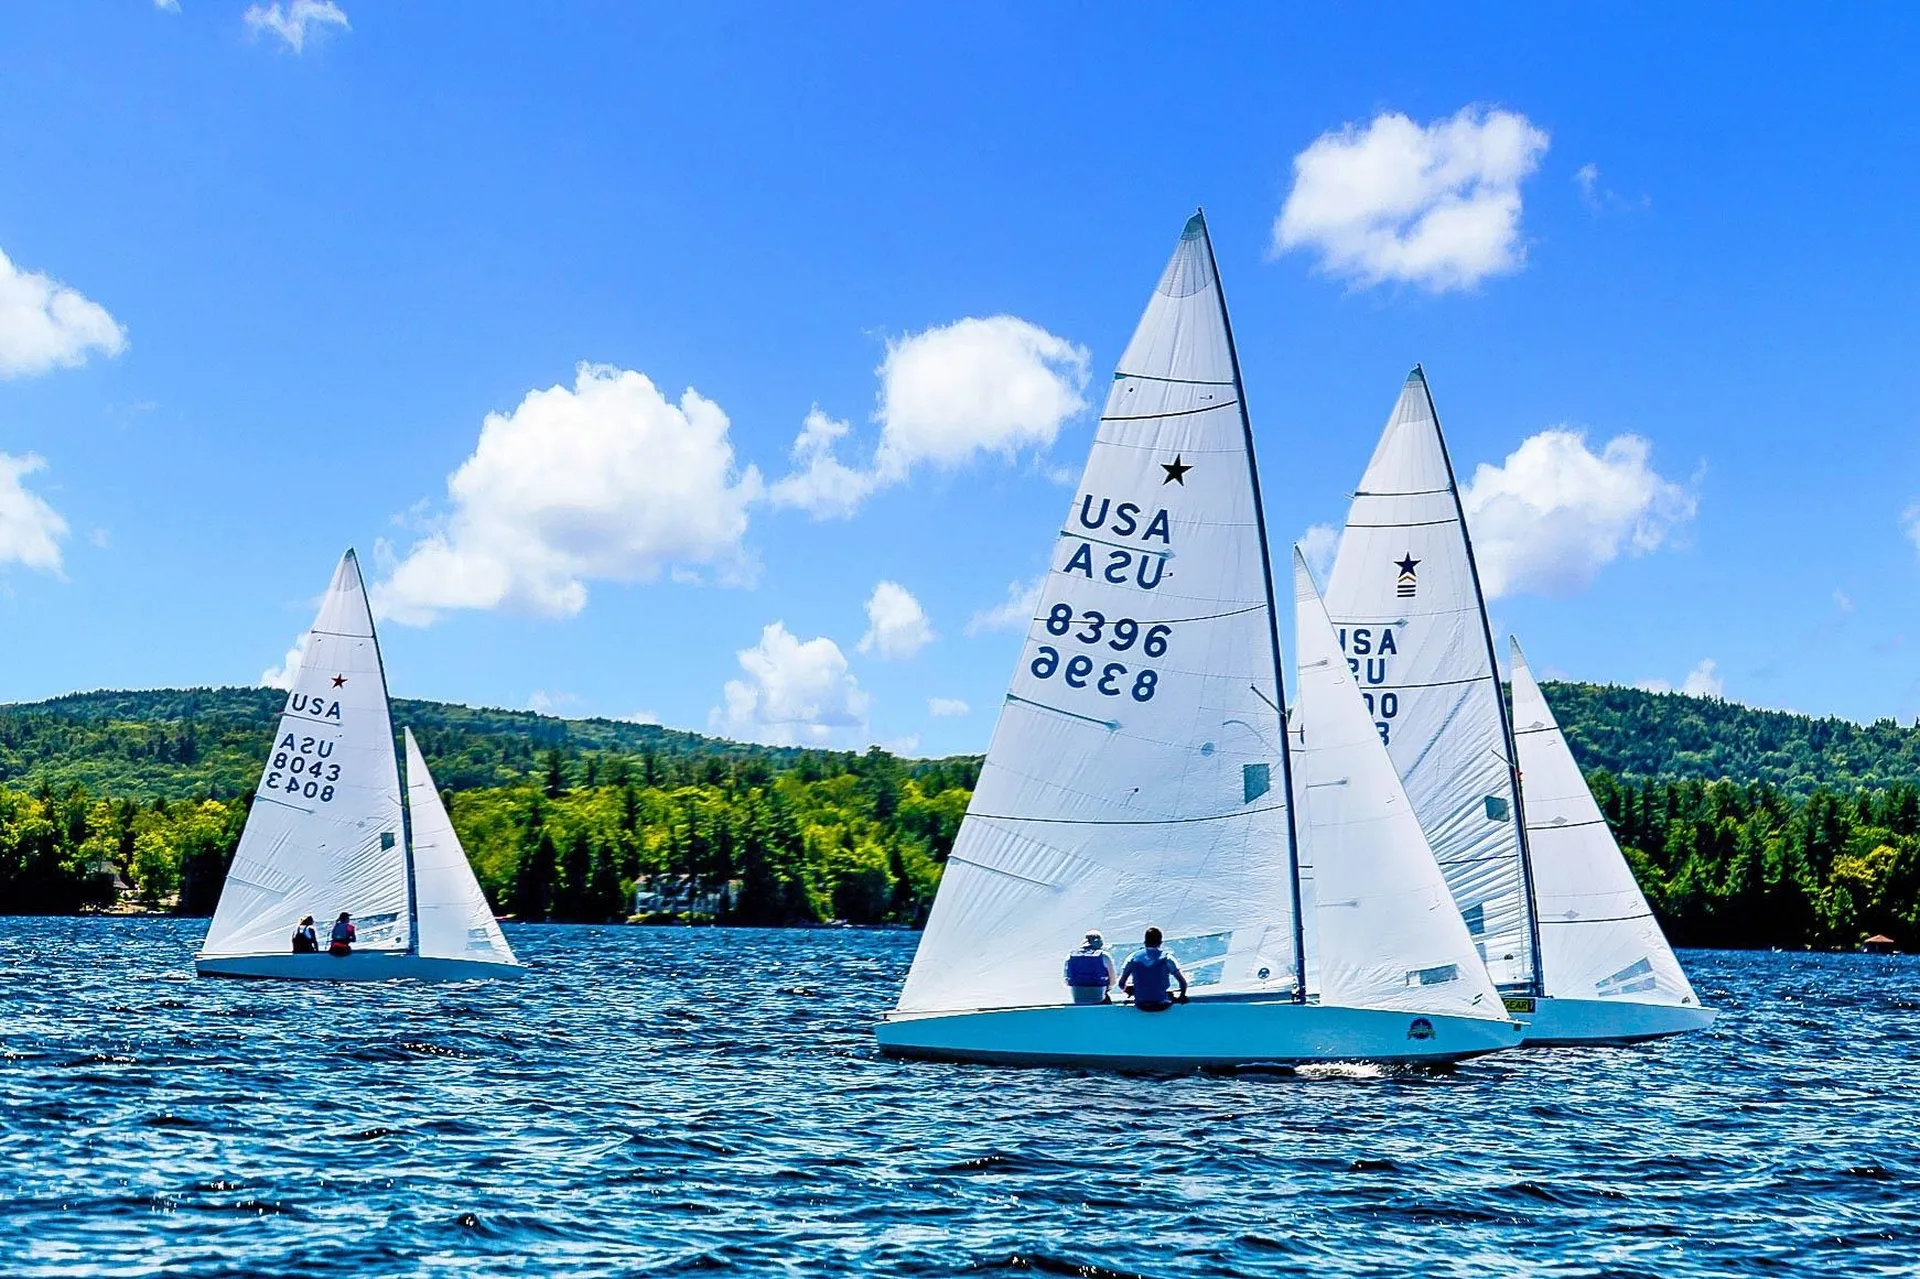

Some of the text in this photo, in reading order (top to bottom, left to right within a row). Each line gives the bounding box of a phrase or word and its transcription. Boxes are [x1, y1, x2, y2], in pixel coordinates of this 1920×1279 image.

[1080, 494, 1170, 544] USA
[1046, 603, 1172, 658] 8396
[292, 693, 340, 720] USA
[273, 752, 340, 781] 8043
